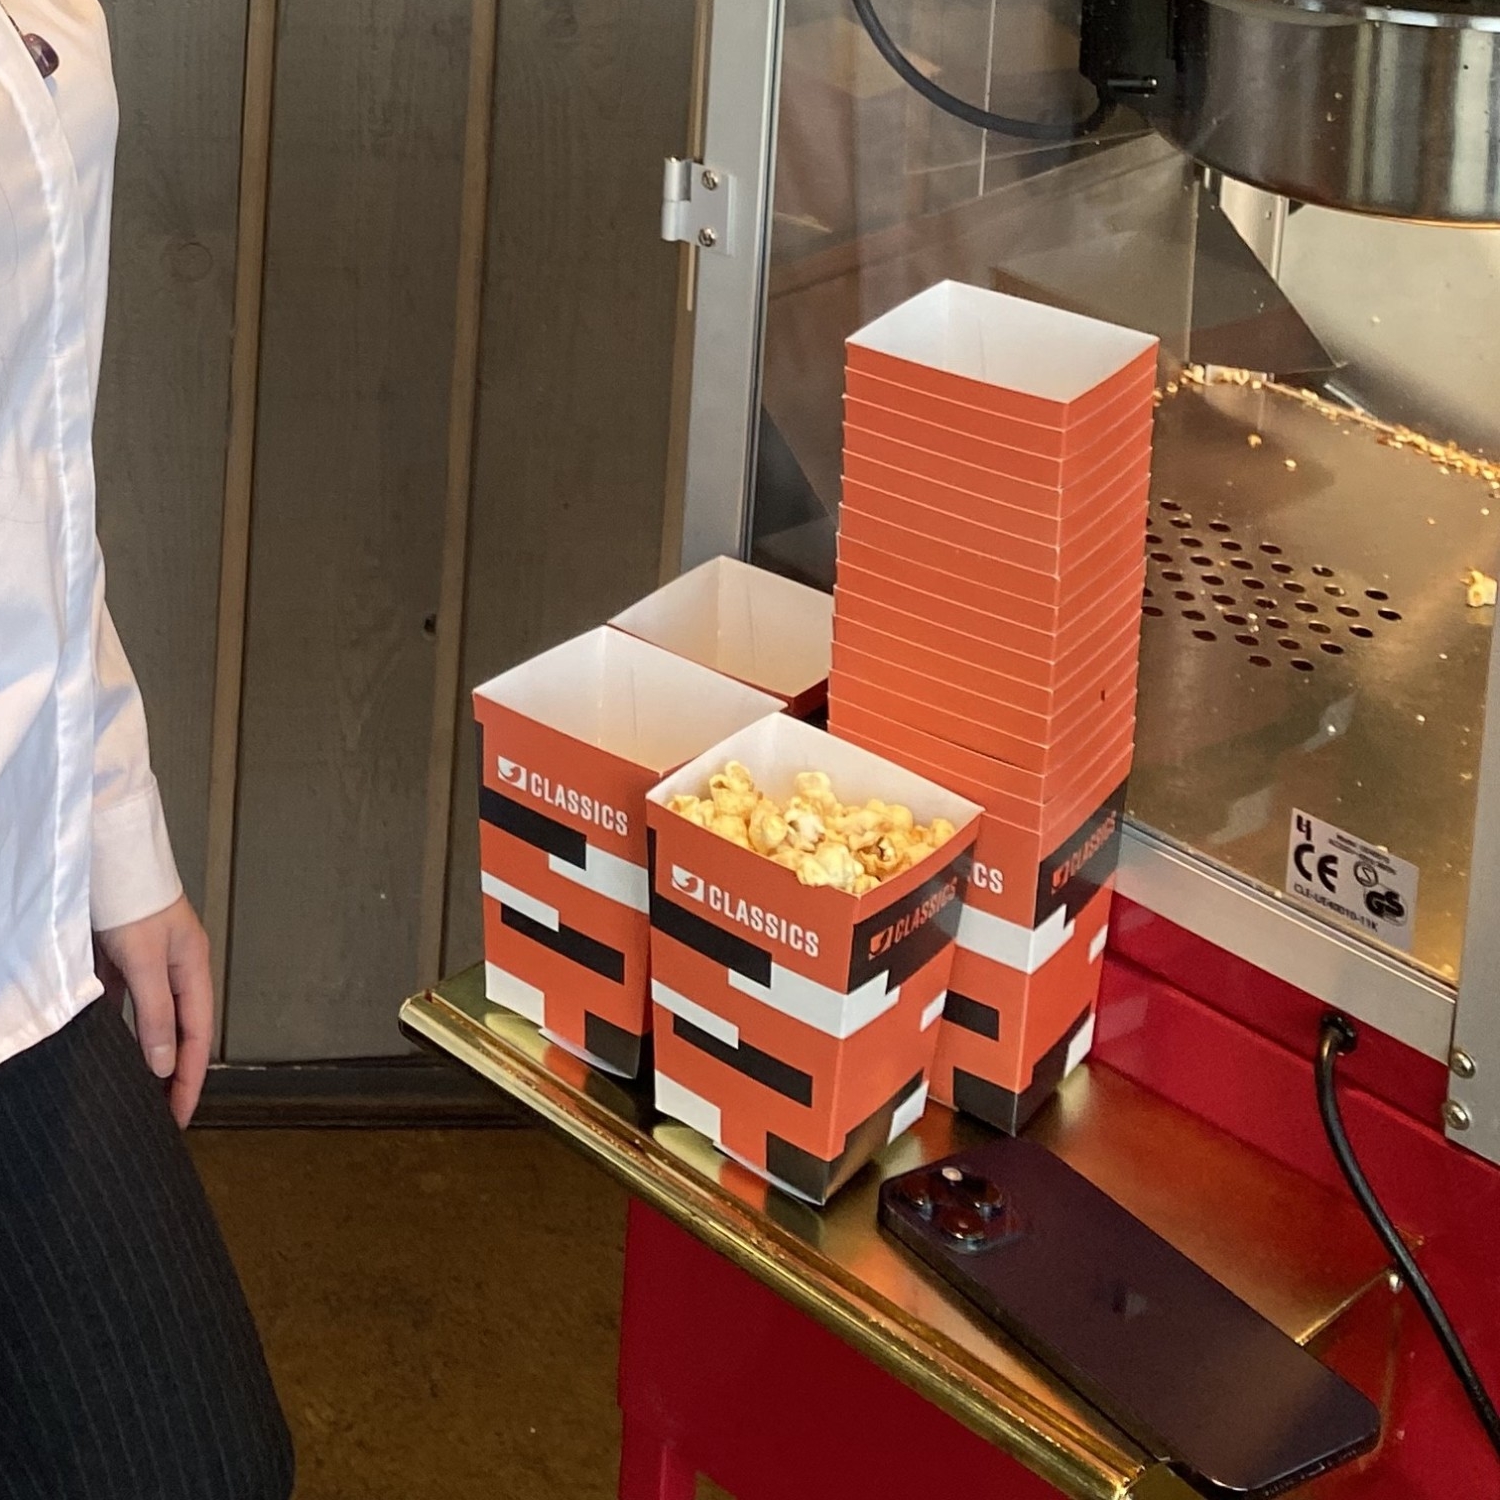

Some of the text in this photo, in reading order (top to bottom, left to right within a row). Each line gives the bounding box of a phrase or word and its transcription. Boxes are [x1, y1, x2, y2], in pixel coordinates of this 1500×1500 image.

[531, 772, 628, 836] CLASSICS
[970, 863, 1003, 894] CS
[1294, 843, 1339, 894] CE
[709, 885, 819, 957] CLASSICS
[894, 877, 957, 942] CLASSICS
[1365, 890, 1405, 918] GS
